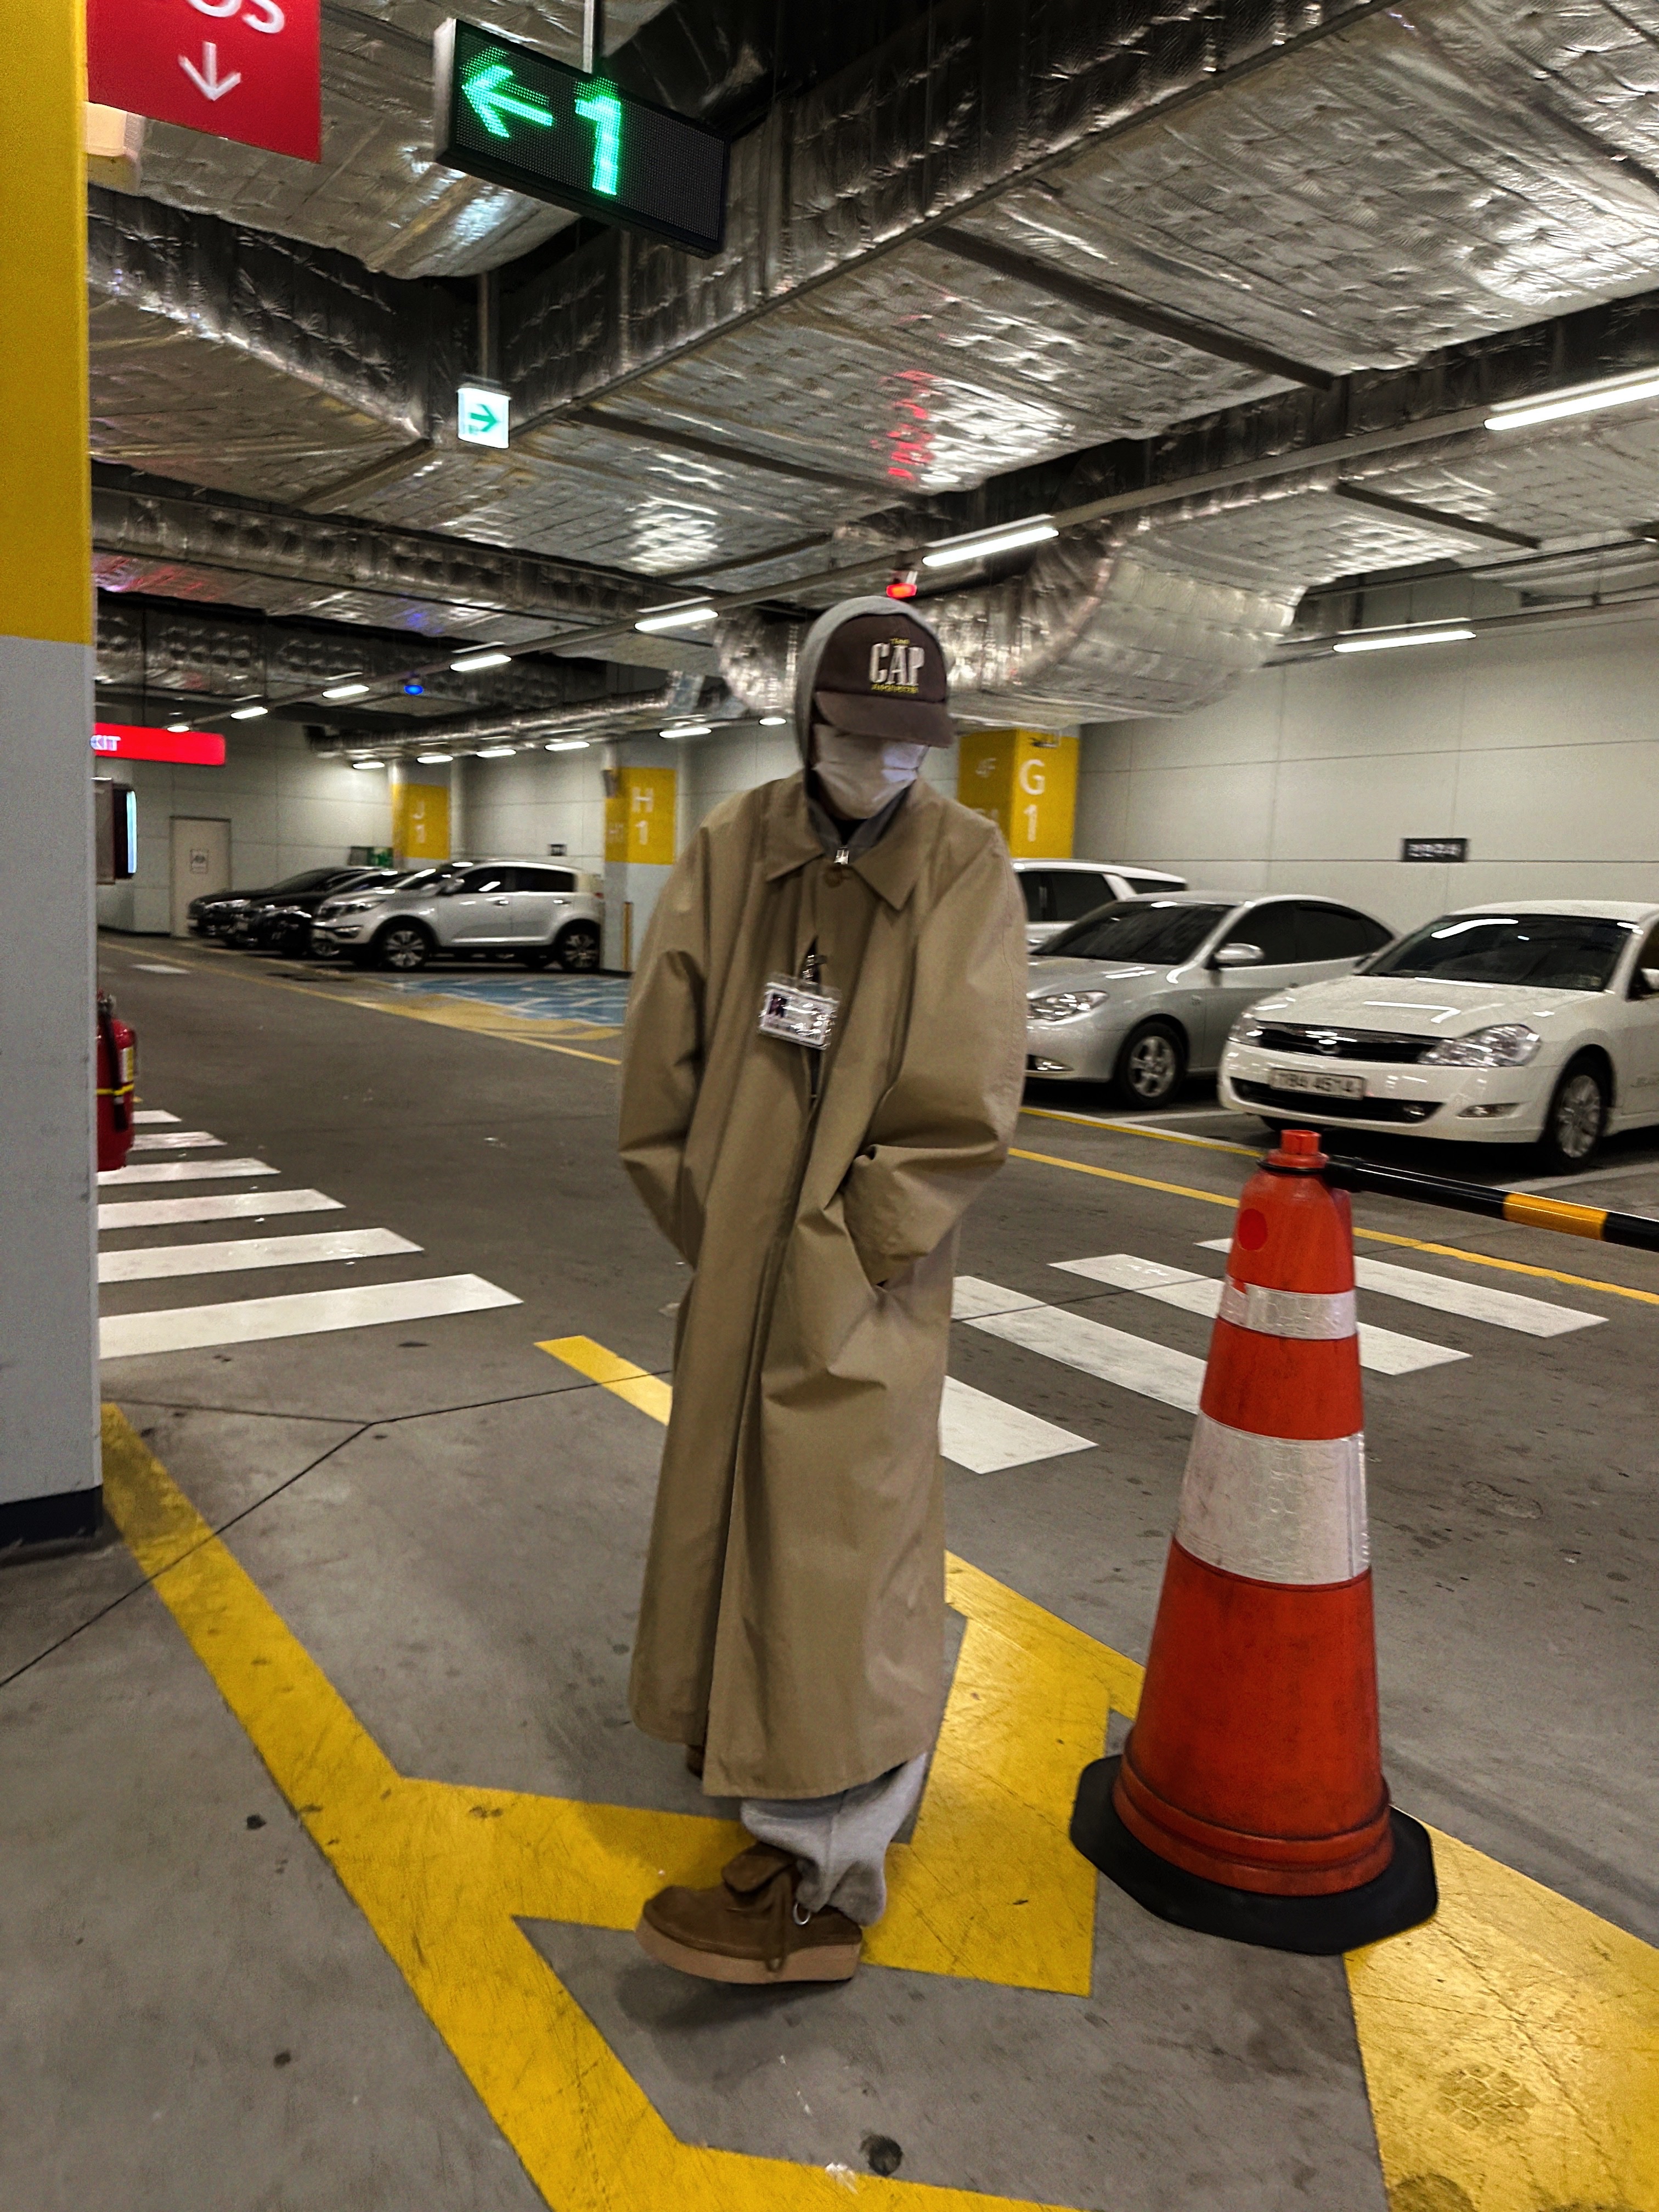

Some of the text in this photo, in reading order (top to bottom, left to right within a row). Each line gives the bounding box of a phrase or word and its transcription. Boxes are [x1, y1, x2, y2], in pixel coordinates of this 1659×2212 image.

[869, 642, 925, 686] CAP
[1019, 759, 1046, 795] G
[412, 800, 425, 820] J
[631, 786, 654, 813] H
[415, 824, 426, 843] 1
[635, 820, 648, 845] 1
[1024, 804, 1038, 843] 1
